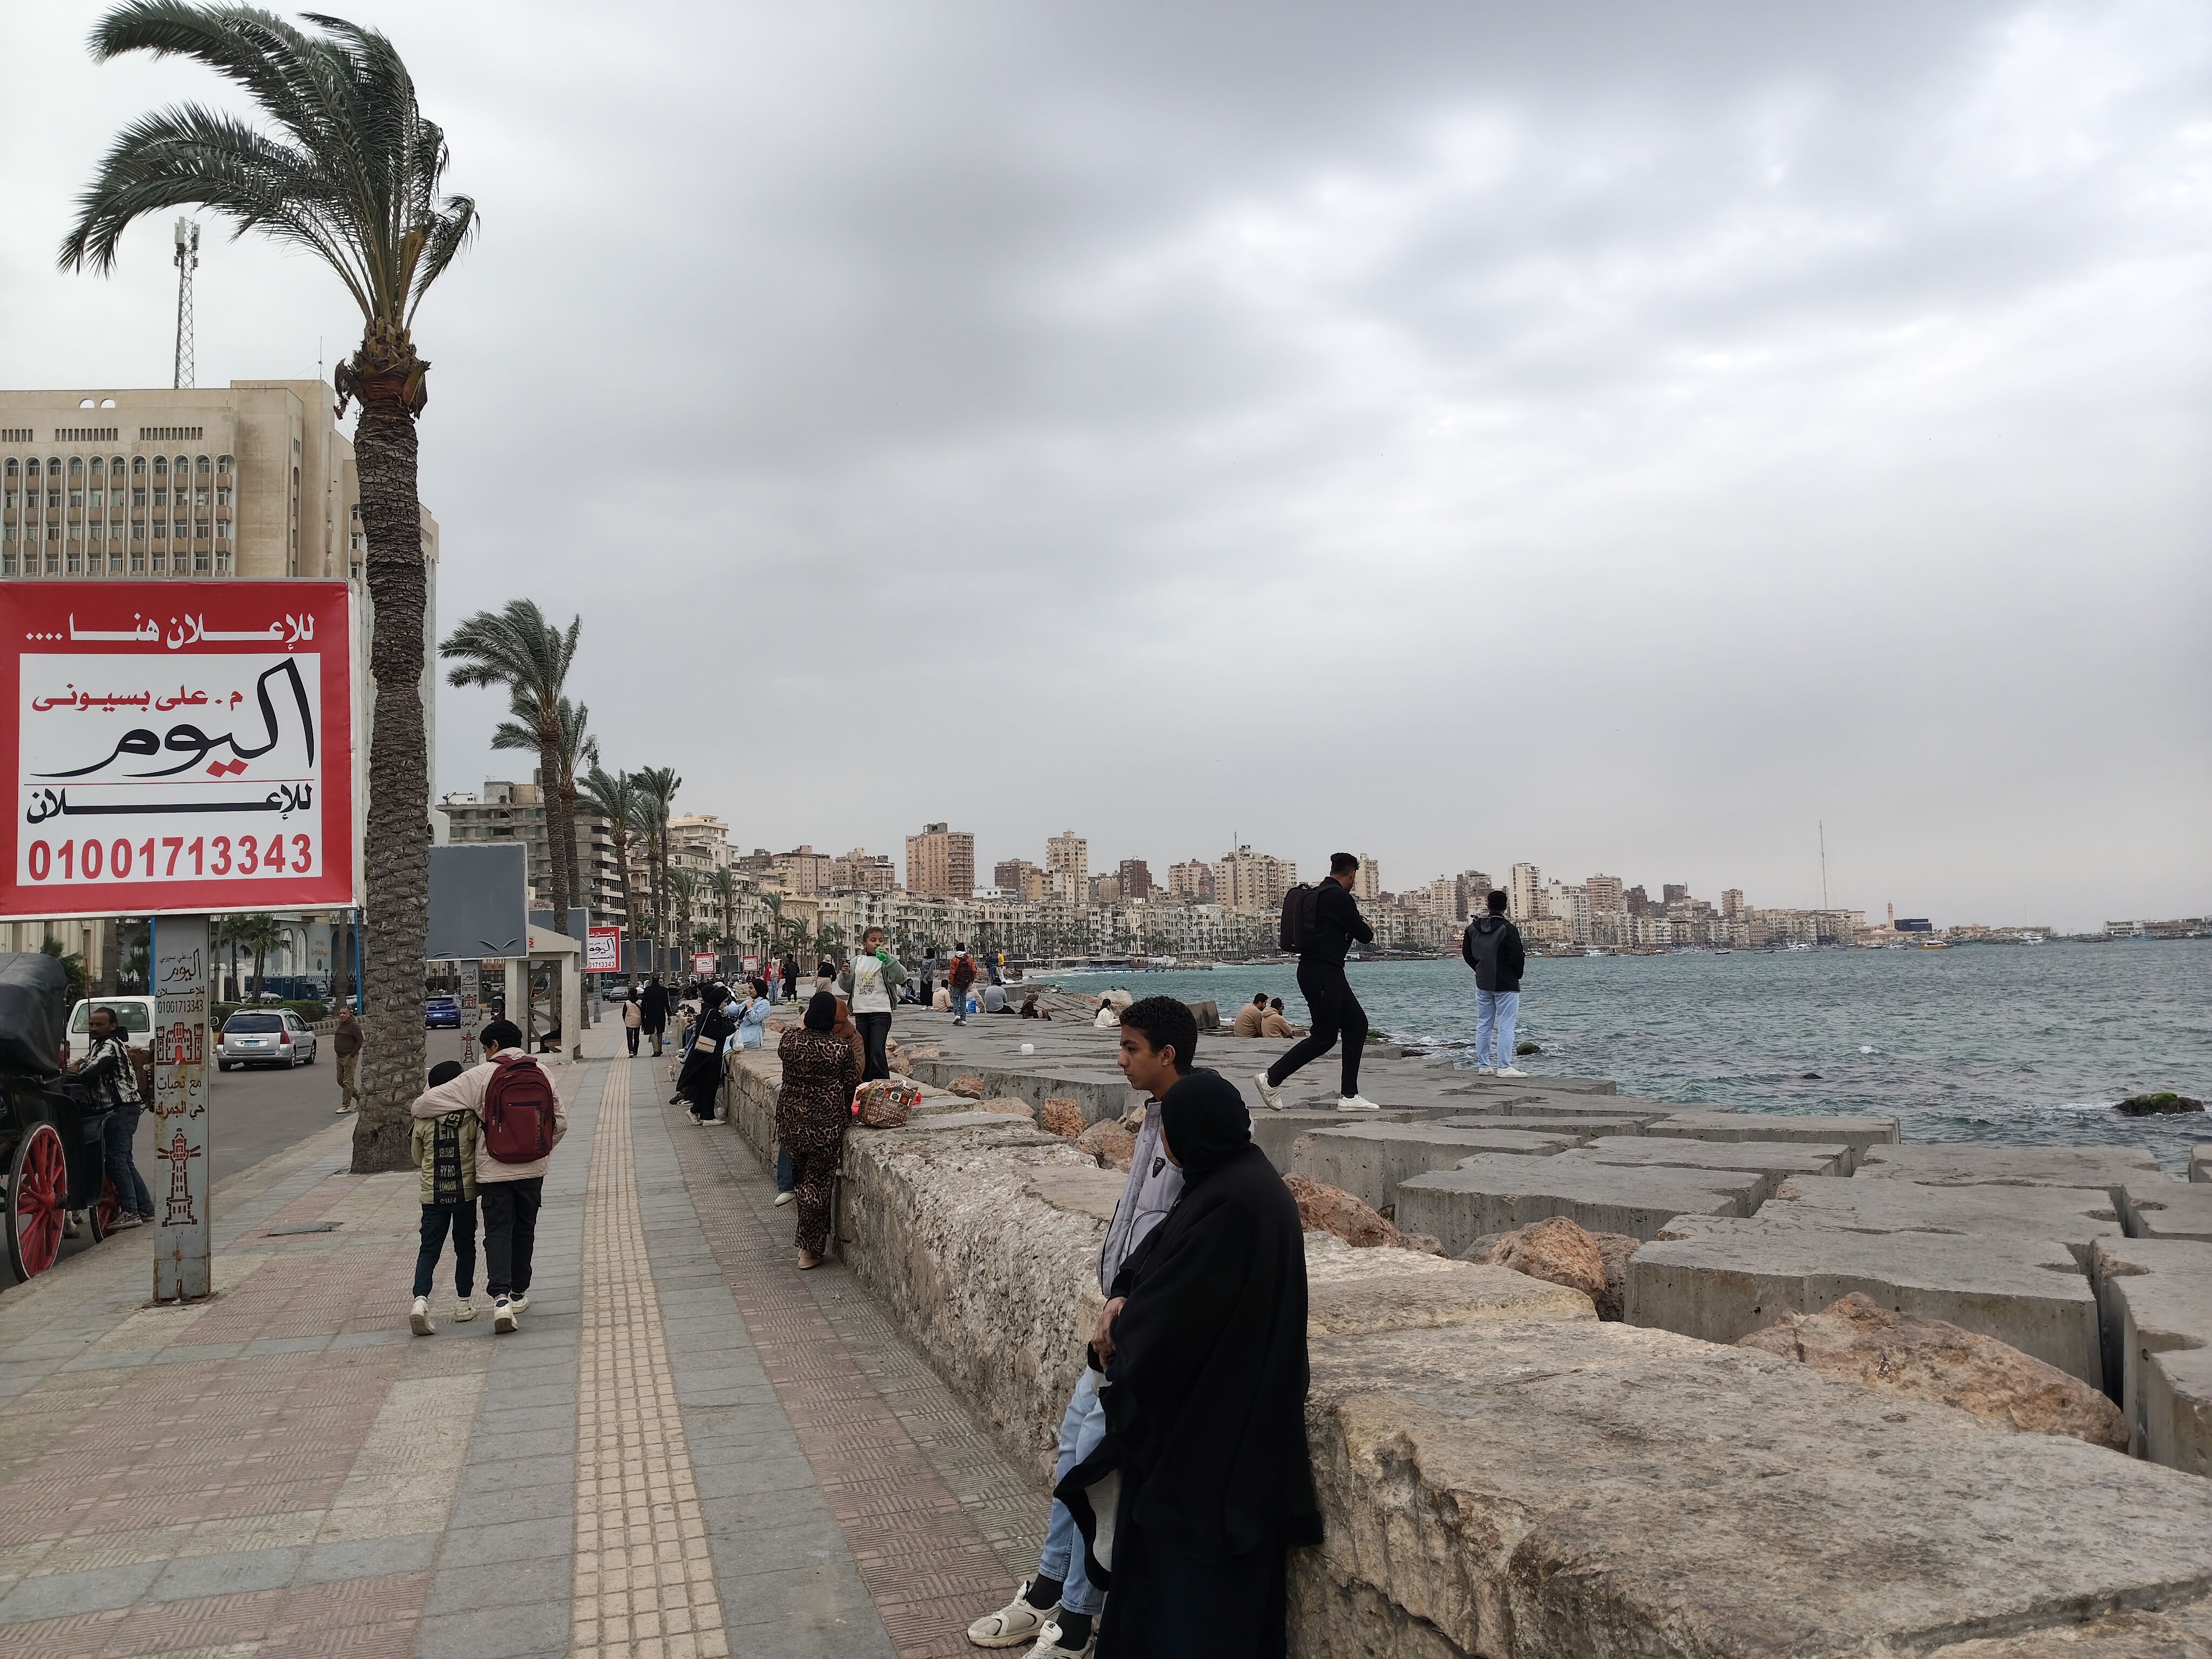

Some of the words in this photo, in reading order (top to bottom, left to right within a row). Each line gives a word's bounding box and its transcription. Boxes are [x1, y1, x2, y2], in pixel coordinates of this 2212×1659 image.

[69, 612, 160, 641] هنا
[166, 612, 315, 651] للإعلان
[155, 684, 208, 711] على
[30, 657, 315, 778] اليوم
[26, 783, 312, 824] للإعلان
[29, 834, 312, 881] 01001713343
[158, 999, 204, 1014] 01001713343
[157, 1074, 185, 1095] تحيات
[189, 1080, 201, 1096] مع
